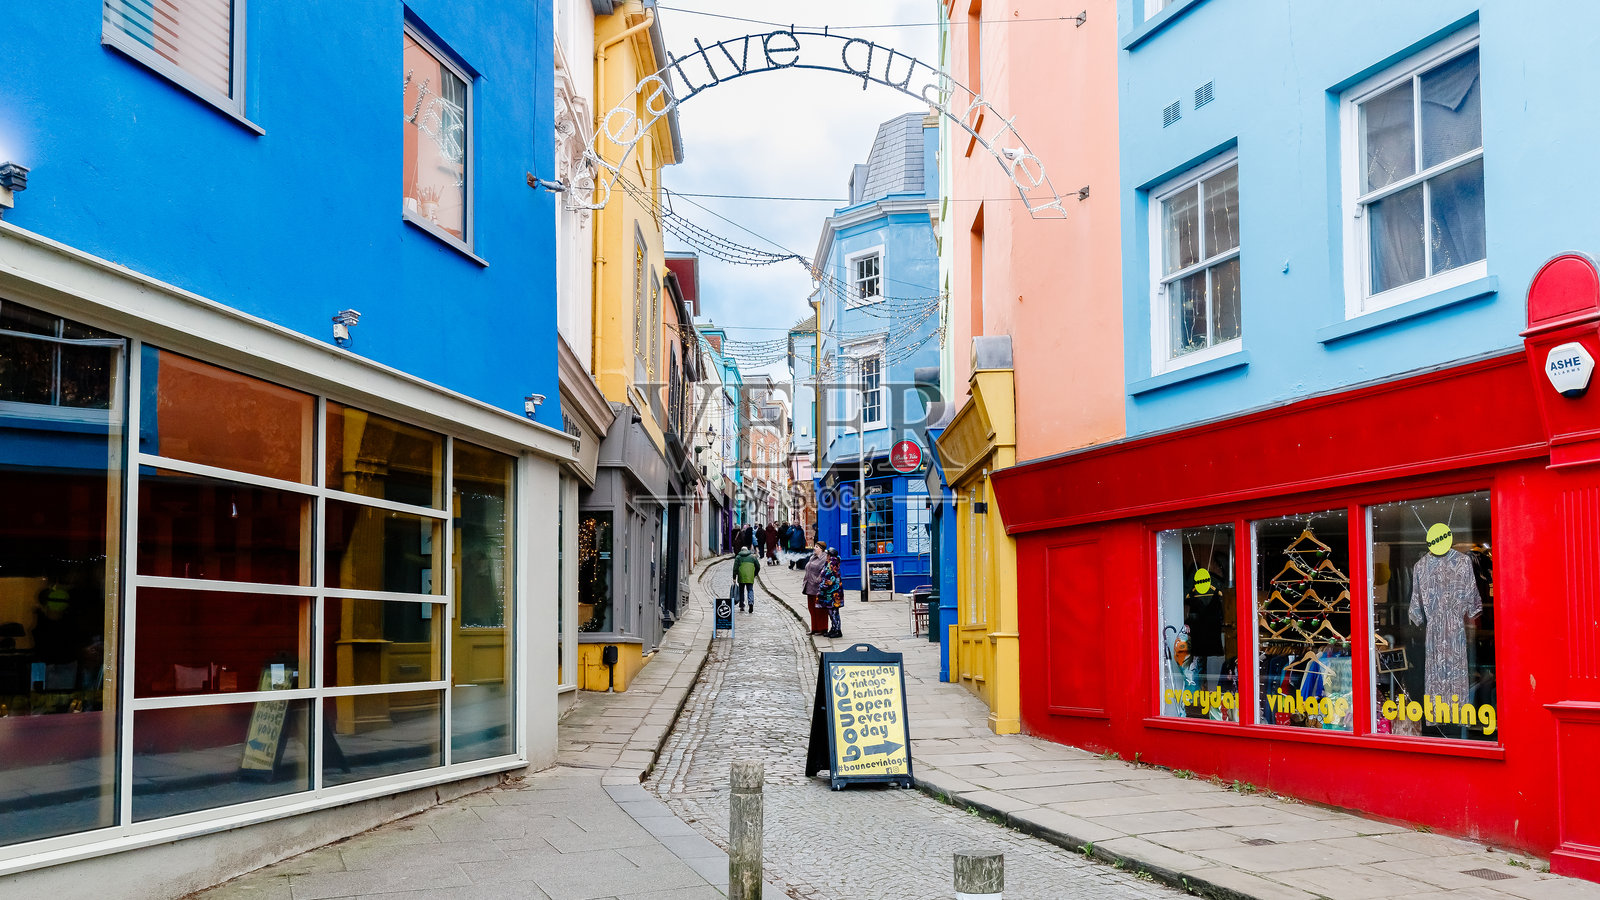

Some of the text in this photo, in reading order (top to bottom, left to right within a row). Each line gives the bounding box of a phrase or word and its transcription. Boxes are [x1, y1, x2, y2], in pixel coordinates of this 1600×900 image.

[571, 30, 800, 209] creative
[842, 38, 1067, 218] quarter
[1550, 356, 1581, 371] ASHE
[1554, 367, 1580, 376] ALARMS
[1427, 531, 1452, 547] bounce
[849, 666, 895, 679] everyday
[850, 677, 887, 688] vintage
[853, 687, 893, 699] fashions
[855, 698, 891, 713] open
[1267, 687, 1348, 723] vintage
[1382, 694, 1496, 735] clothing
[831, 665, 862, 763] bounce
[857, 710, 896, 724] every
[860, 724, 888, 738] day
